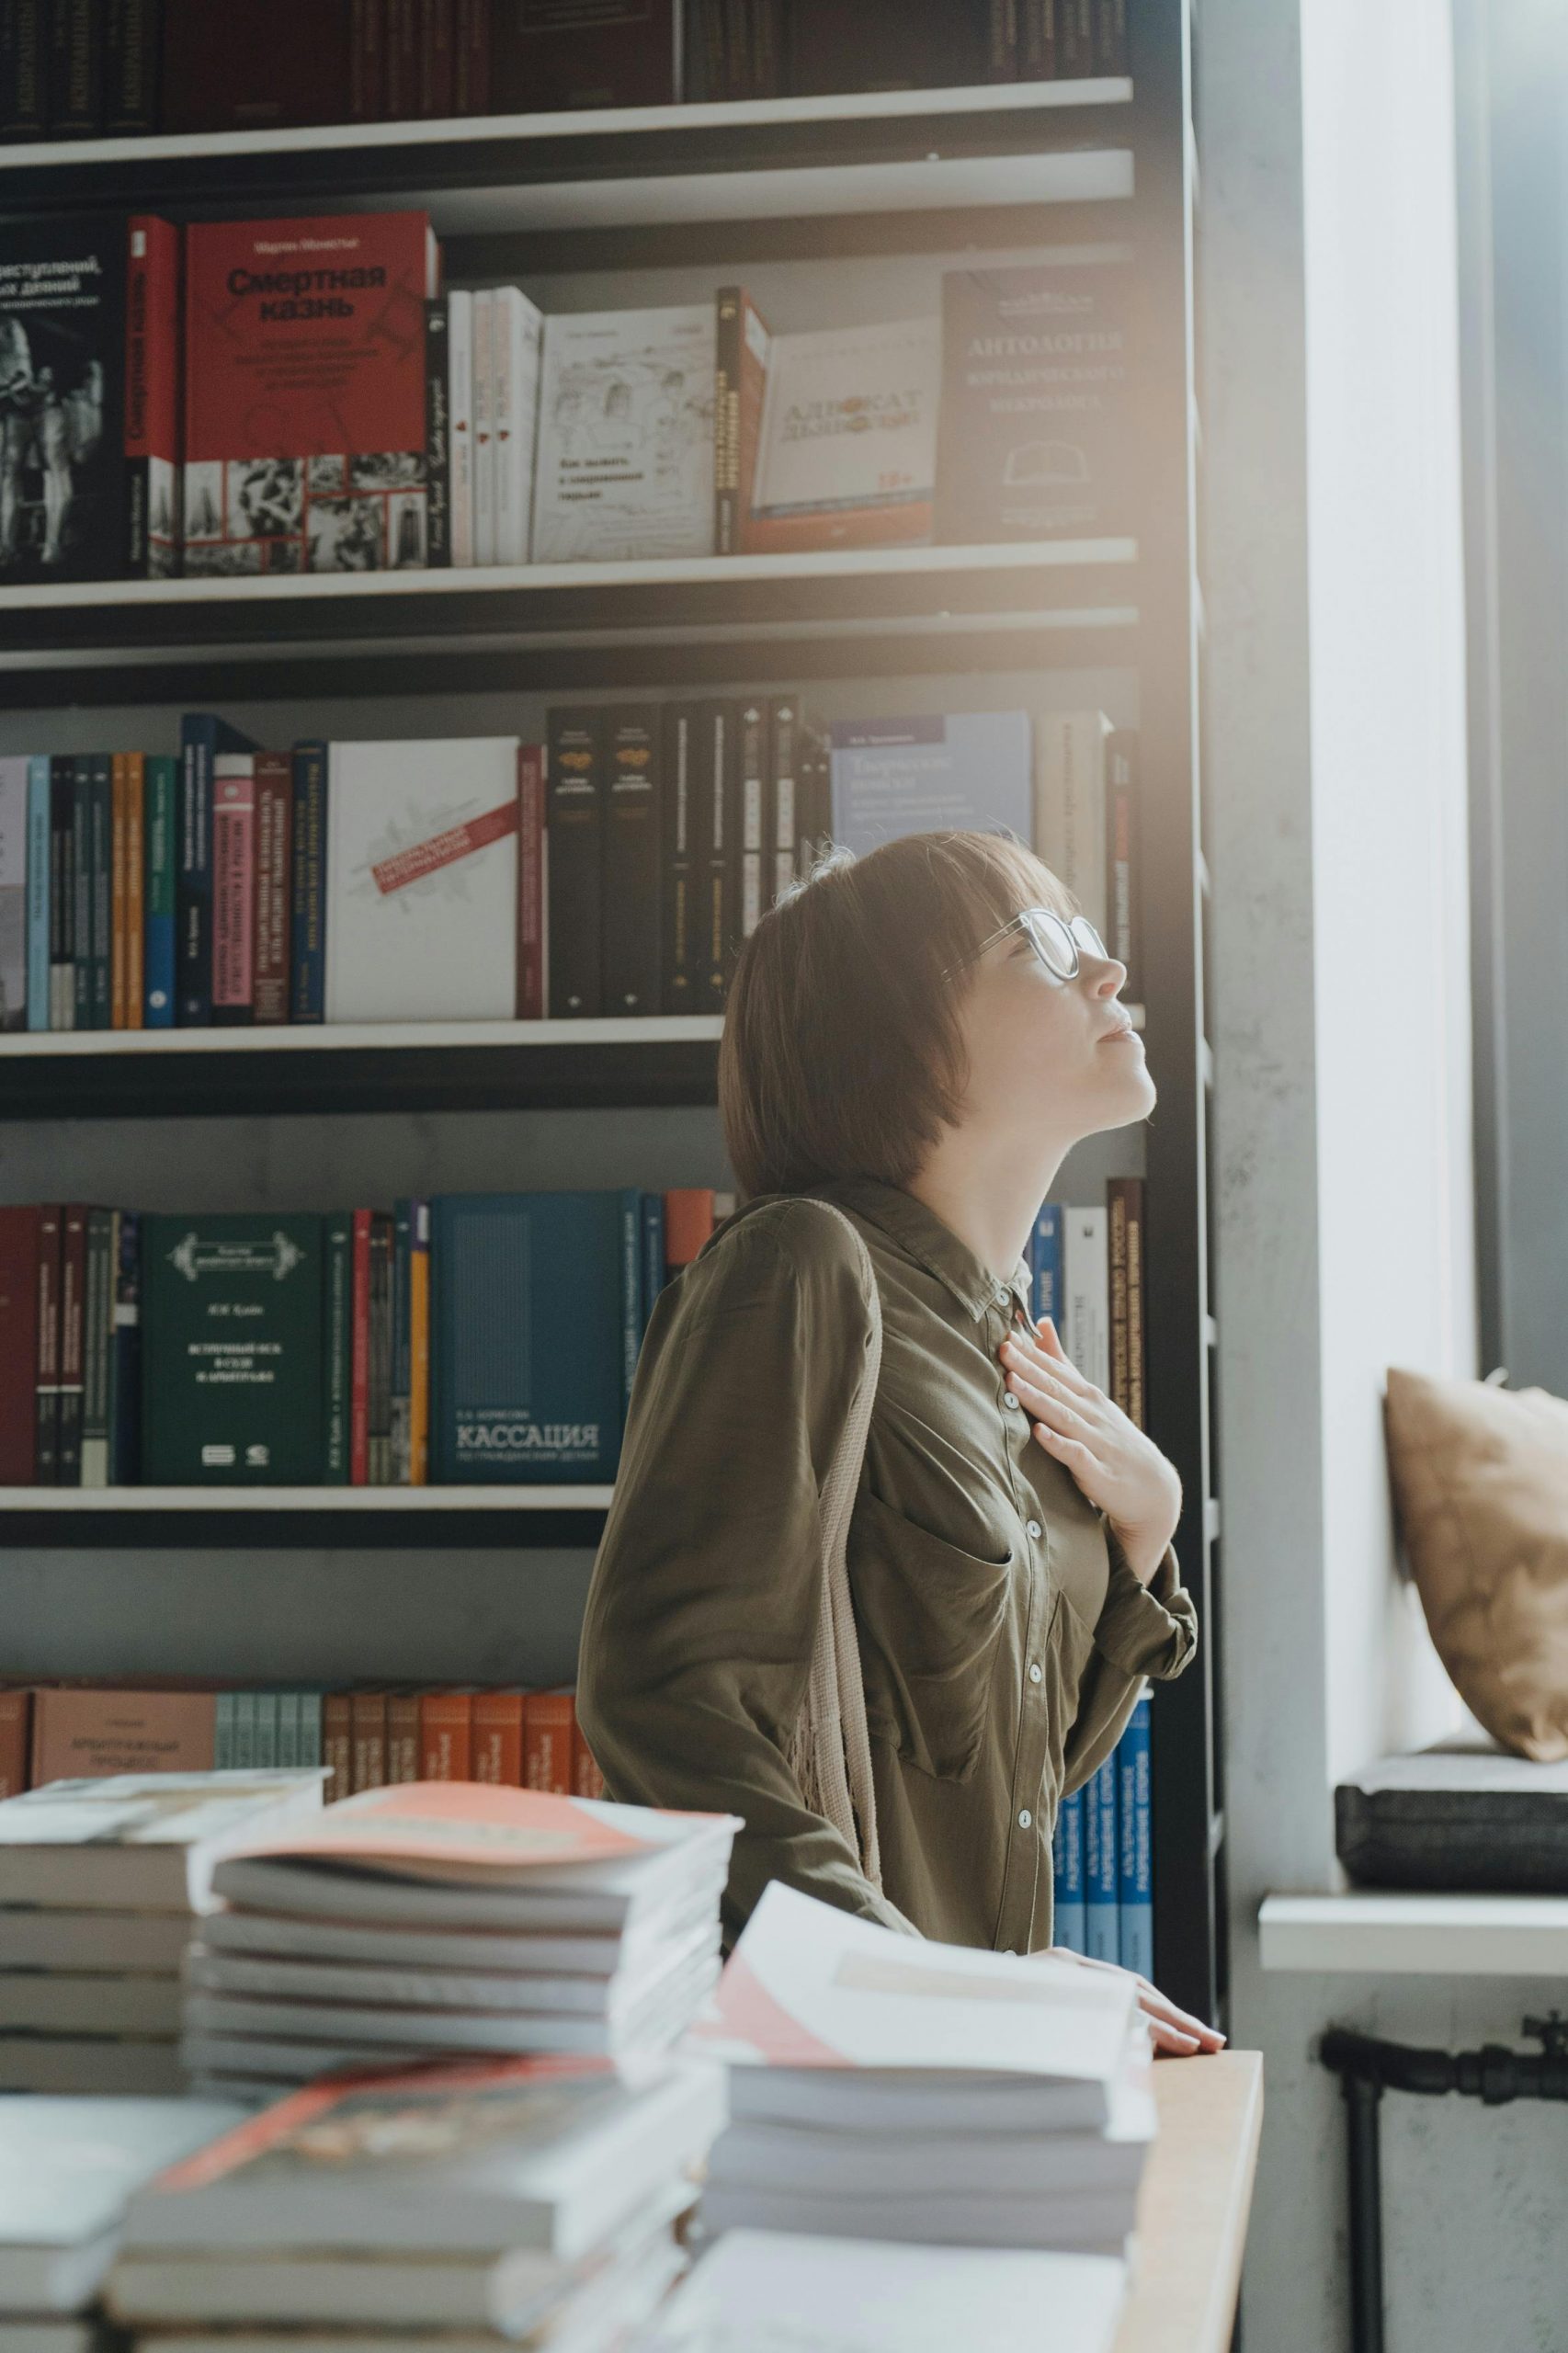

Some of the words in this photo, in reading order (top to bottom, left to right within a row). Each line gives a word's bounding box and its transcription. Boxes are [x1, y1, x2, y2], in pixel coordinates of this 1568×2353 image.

[226, 265, 387, 297] Смертная
[258, 296, 355, 322] казнь
[967, 330, 1124, 357] АНТОЛОГИЯ
[783, 390, 922, 425] АДВОКАТ
[455, 1423, 600, 1450] КАССАЦИЯ
[1136, 1750, 1149, 1804] СПОРОВ
[1100, 1807, 1114, 1892] РАЗРЕШЕНИЕ
[1136, 1807, 1149, 1893] РАЗРЕШЕНИЕ
